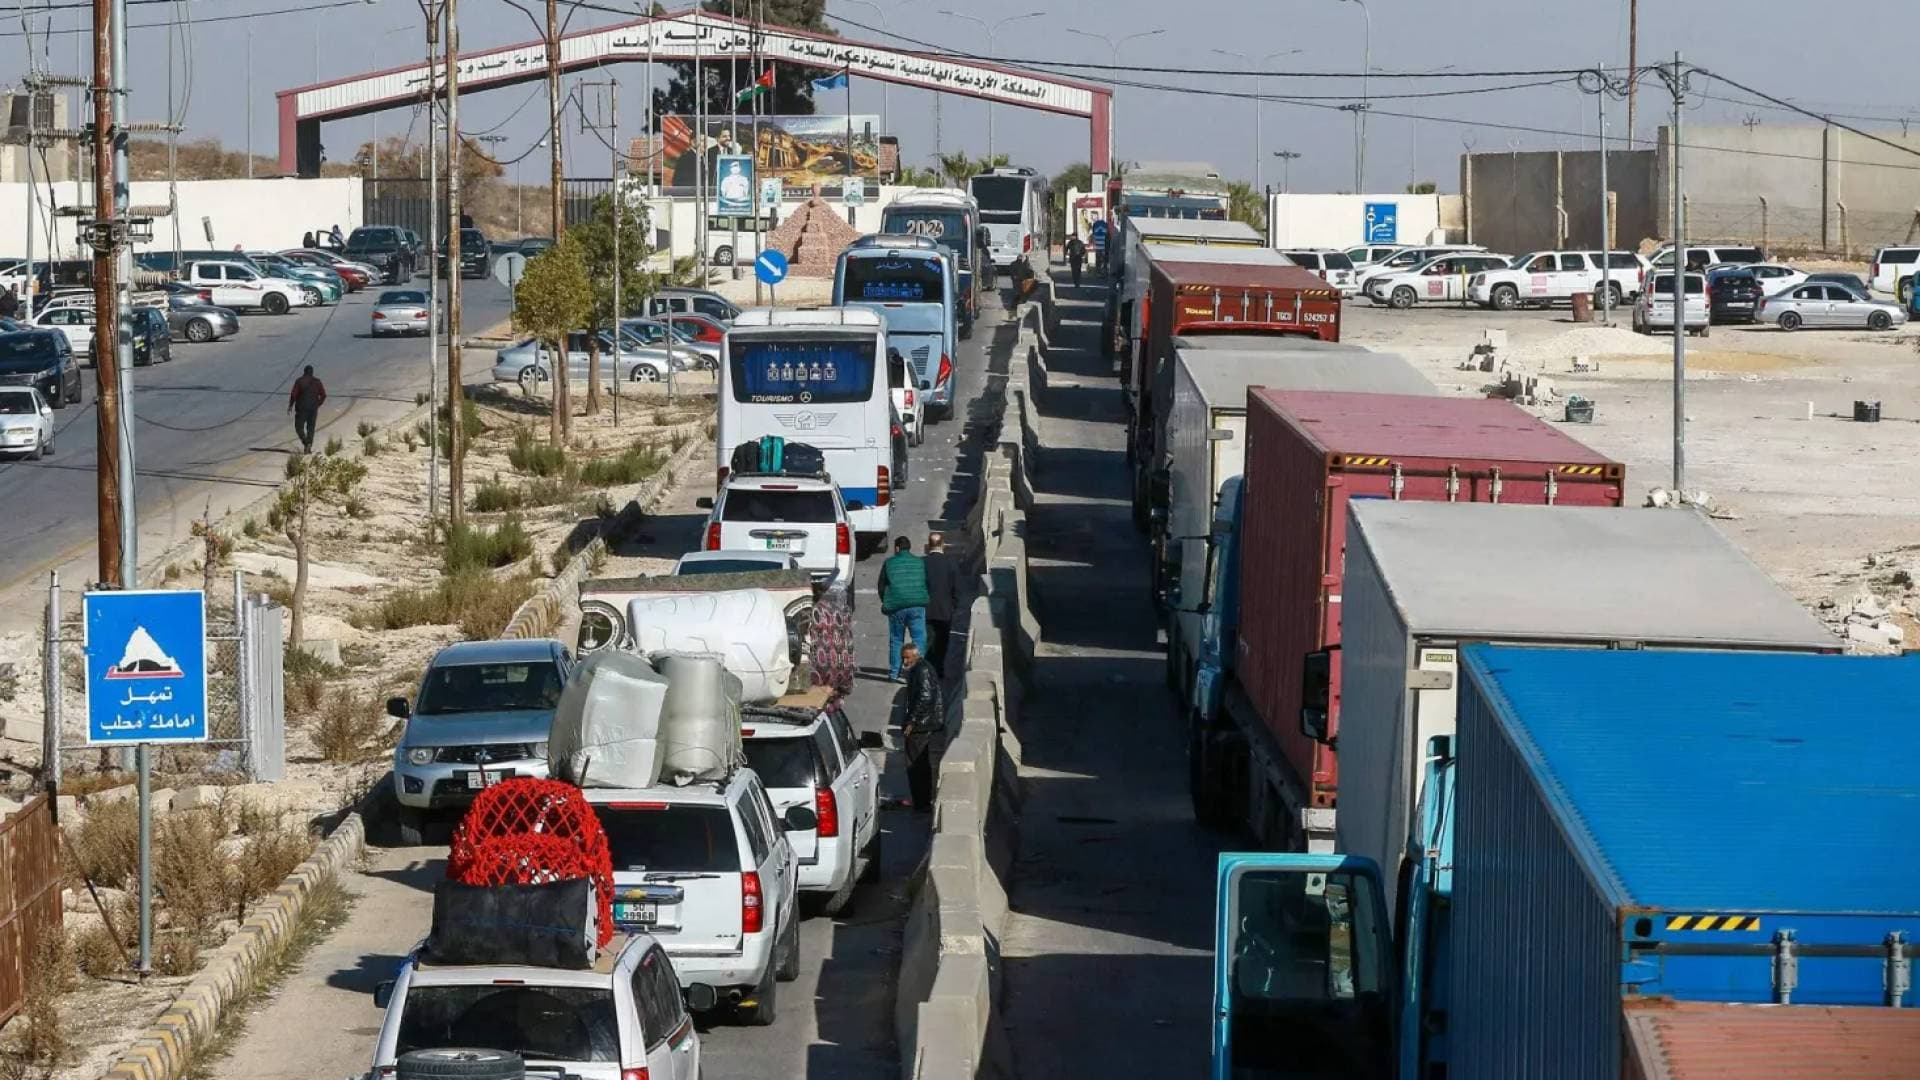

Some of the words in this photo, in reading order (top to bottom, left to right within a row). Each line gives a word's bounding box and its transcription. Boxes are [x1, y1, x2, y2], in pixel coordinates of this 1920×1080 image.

[900, 59, 952, 82] الهاشمية
[1001, 78, 1047, 99] المملكة
[120, 686, 173, 706] تمهل
